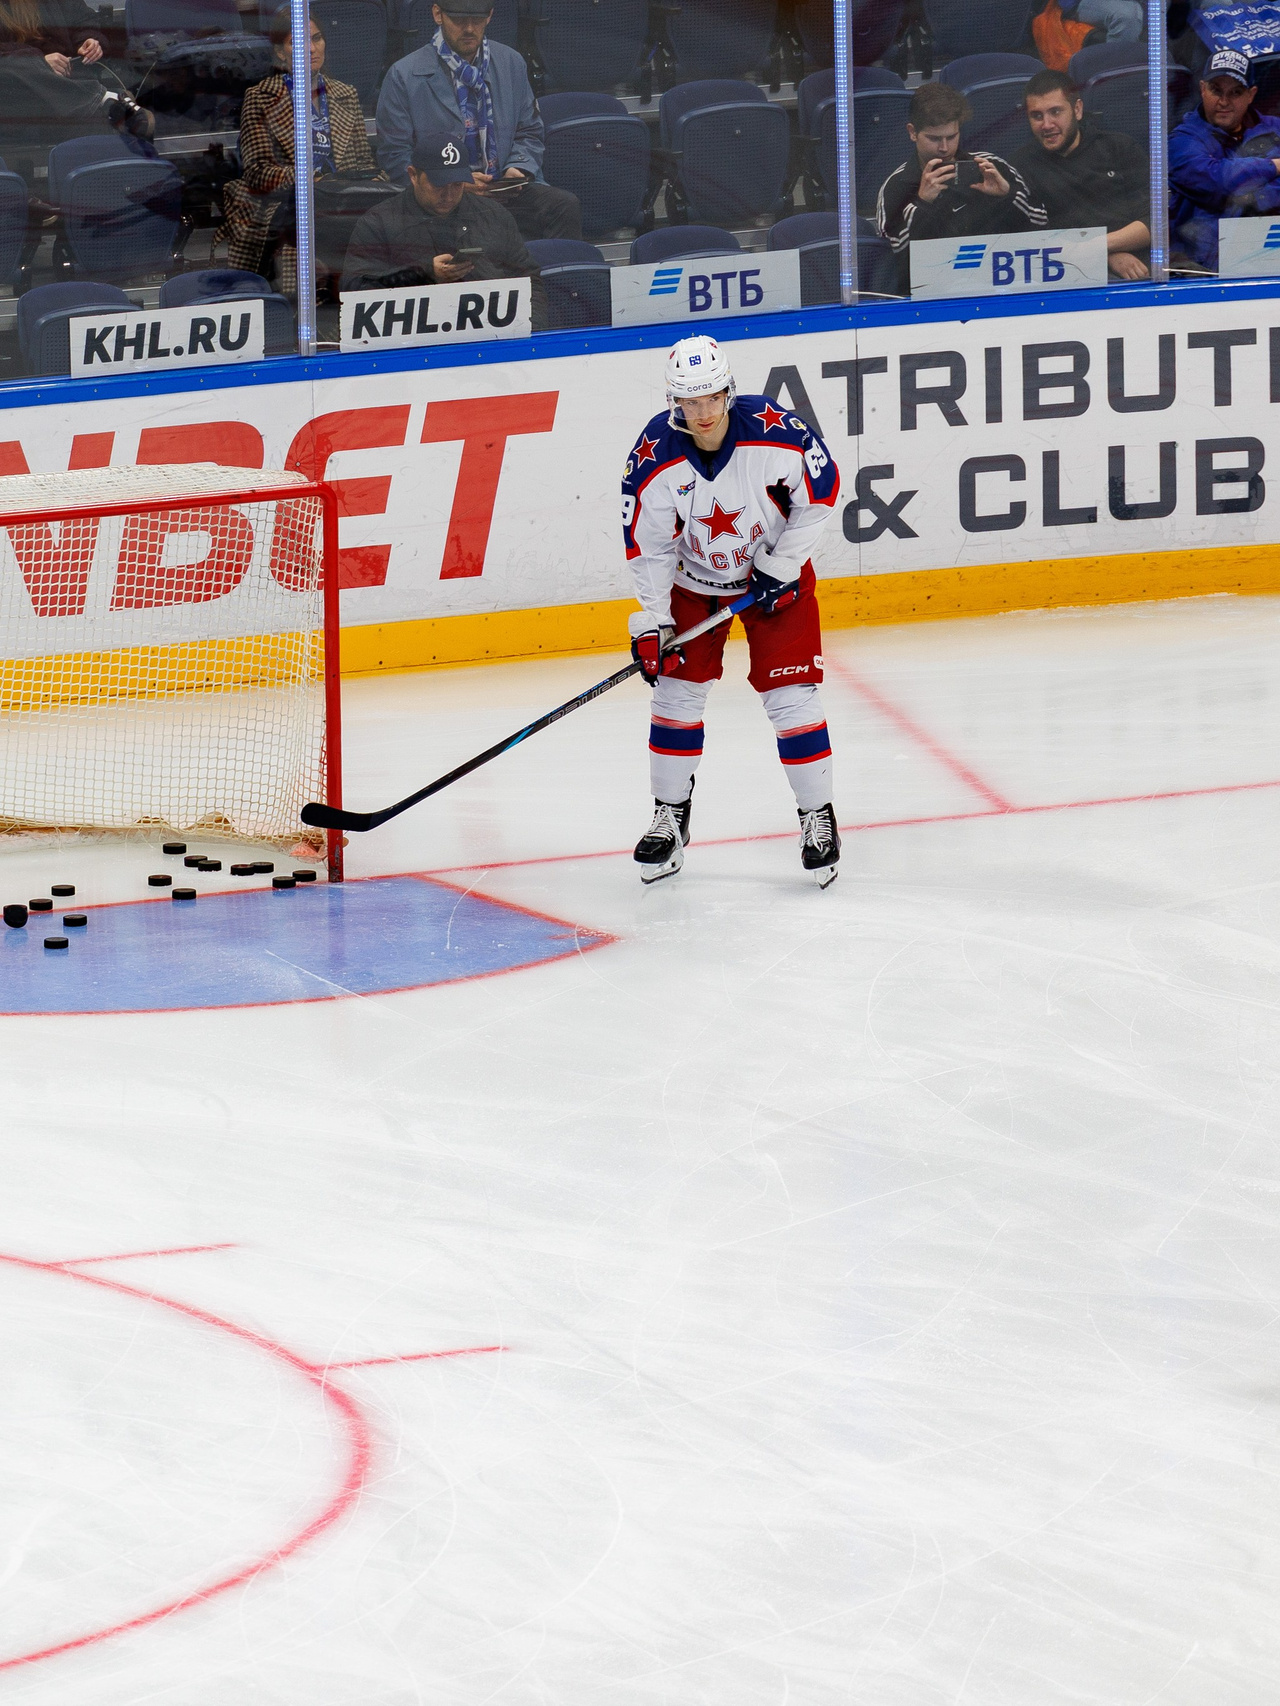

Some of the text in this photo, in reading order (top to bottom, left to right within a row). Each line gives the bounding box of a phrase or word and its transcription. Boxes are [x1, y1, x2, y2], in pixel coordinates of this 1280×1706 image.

[992, 247, 1065, 286] ВТБ
[689, 269, 764, 312] ВТБ
[352, 289, 519, 339] KHL.RU
[83, 312, 251, 365] KHL.RU
[688, 354, 702, 367] 69
[686, 382, 713, 393] согаз
[842, 436, 1266, 544] & CLUB
[689, 520, 765, 571] ЦСКА
[769, 664, 810, 679] CCM
